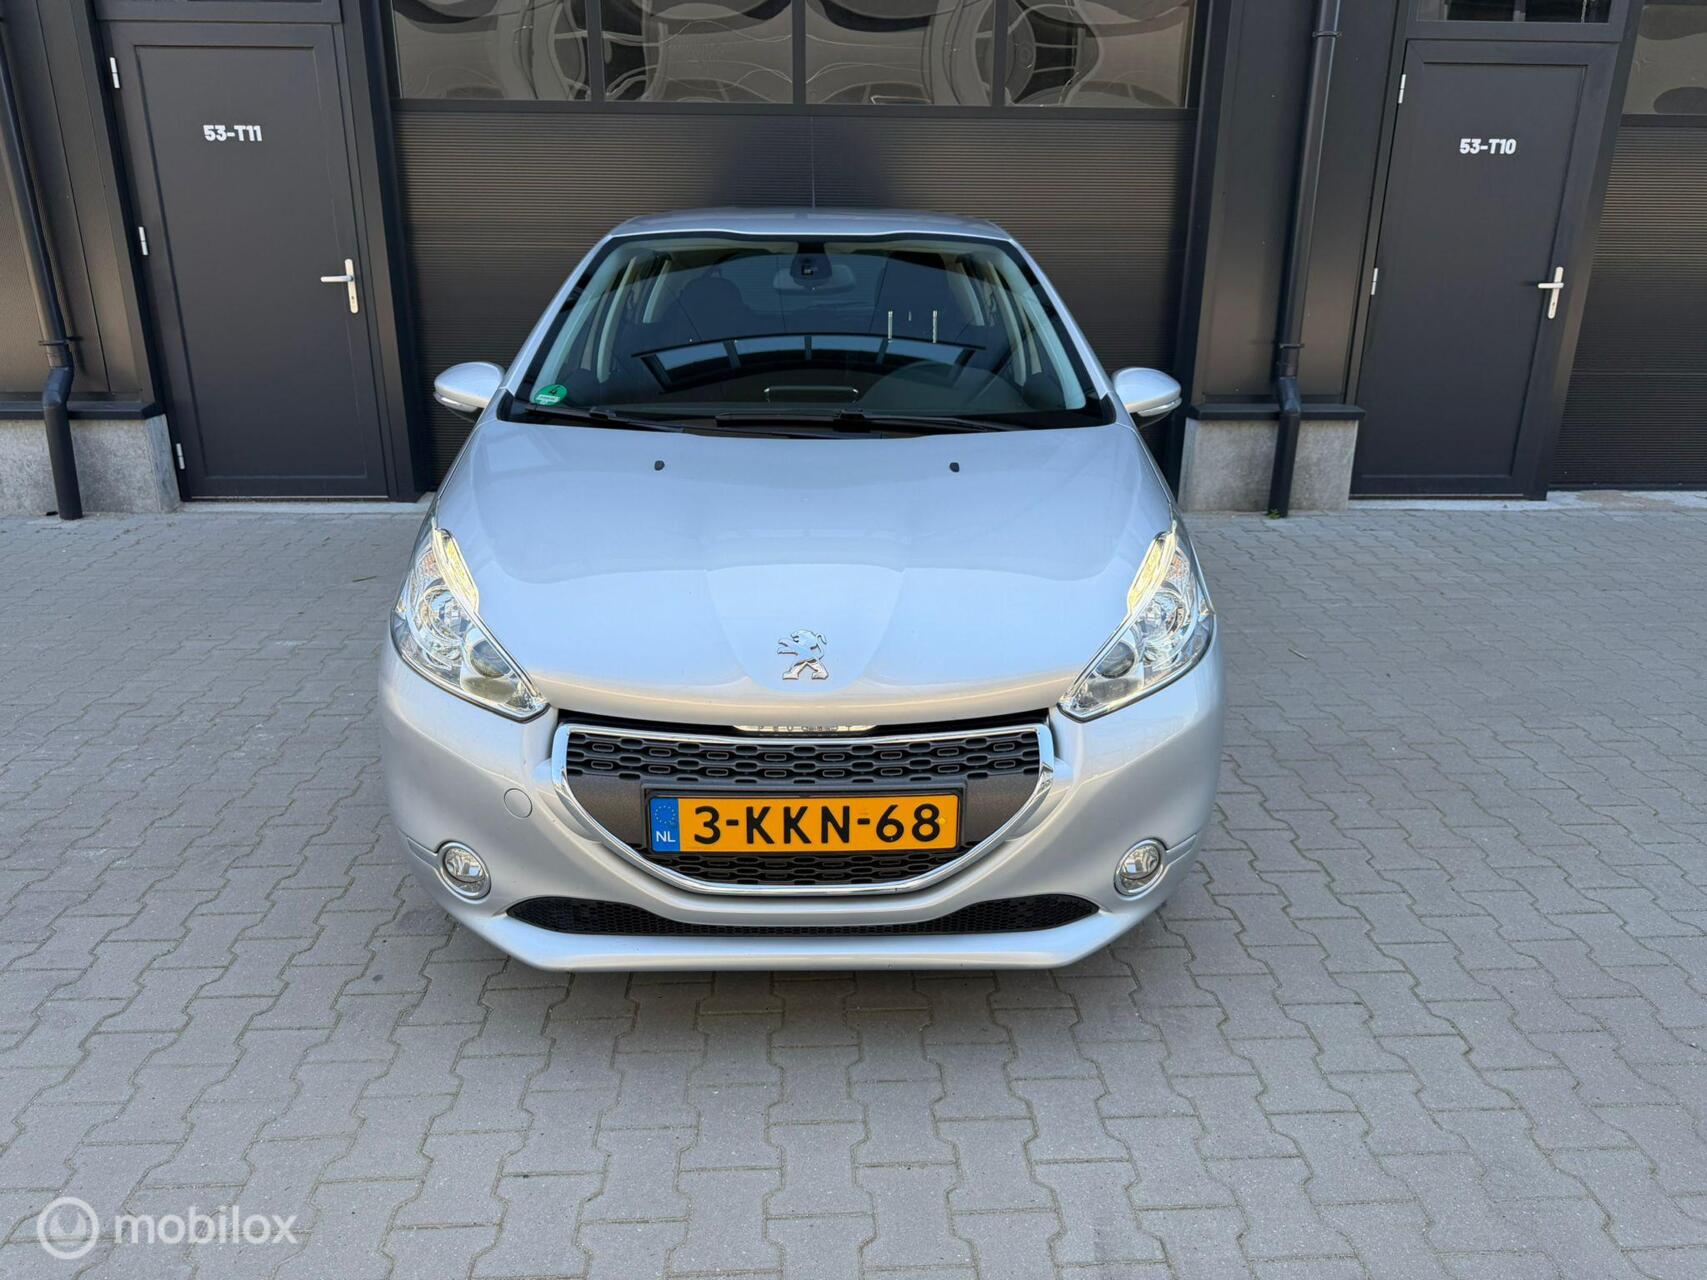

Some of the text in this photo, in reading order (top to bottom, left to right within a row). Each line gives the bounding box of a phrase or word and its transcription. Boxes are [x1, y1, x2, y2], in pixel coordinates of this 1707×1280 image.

[203, 124, 263, 142] 53-T11
[1459, 138, 1517, 155] 53-T10
[693, 802, 942, 845] 3-KKN-68
[655, 829, 676, 843] NL
